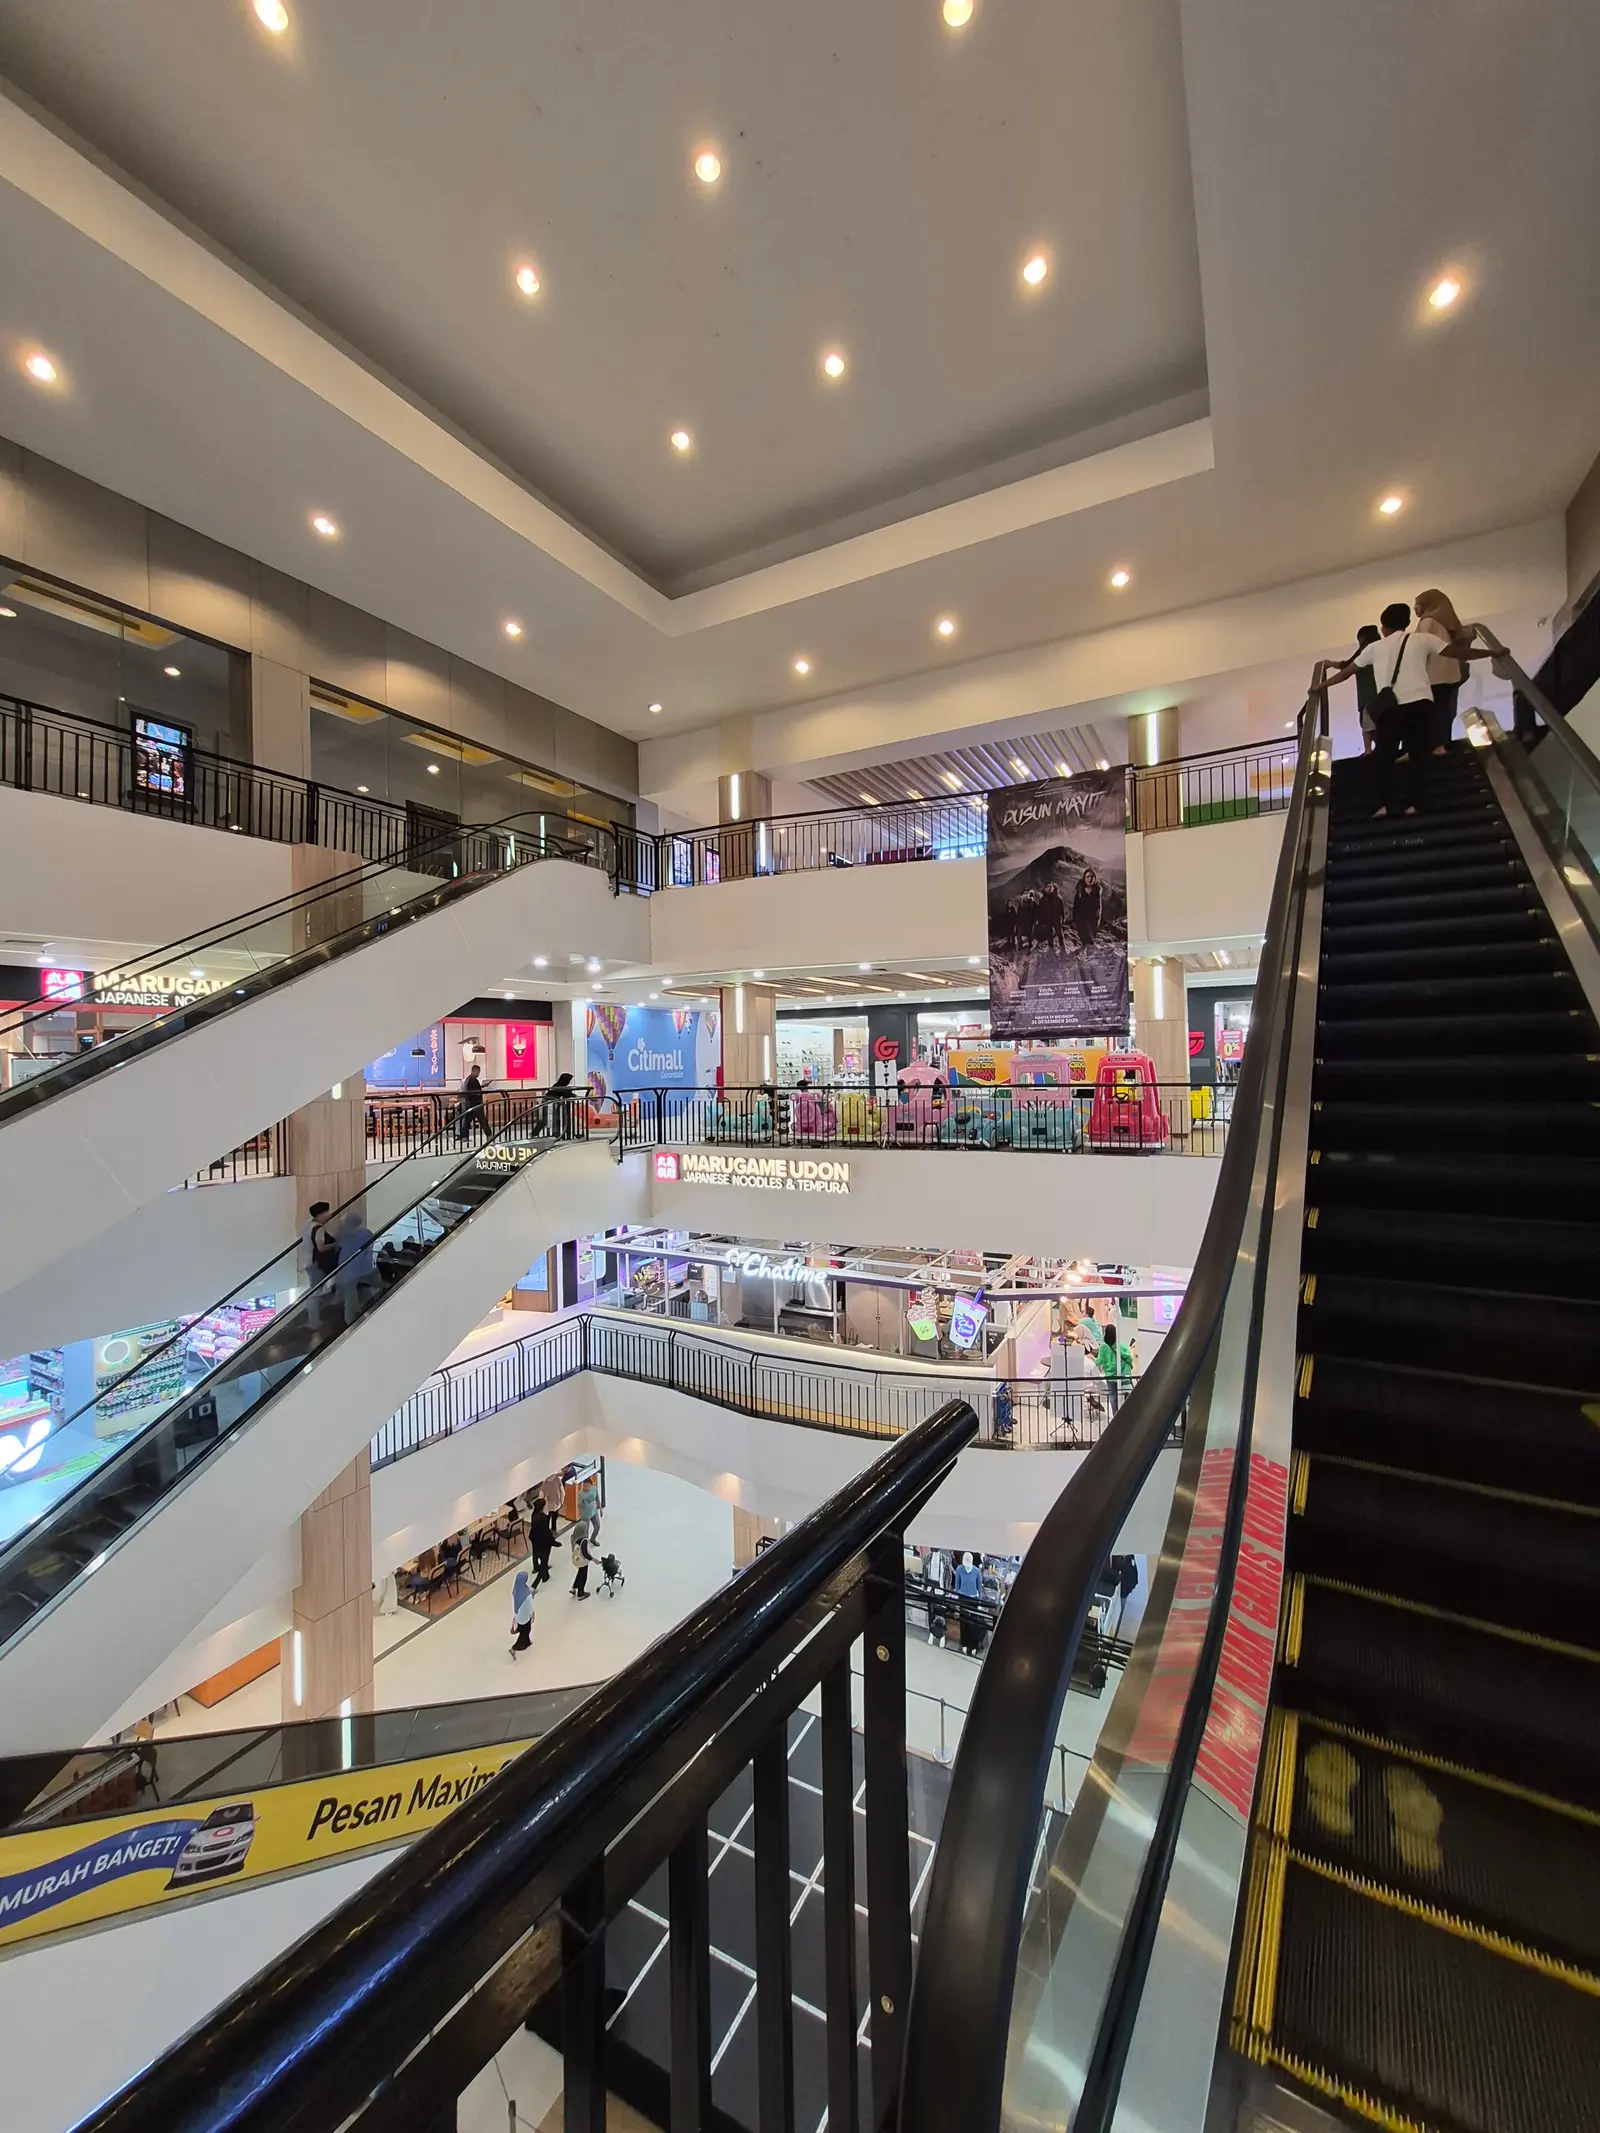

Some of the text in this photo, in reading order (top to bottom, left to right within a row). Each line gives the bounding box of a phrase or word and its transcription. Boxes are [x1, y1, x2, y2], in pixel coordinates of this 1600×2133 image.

[1002, 802, 1053, 827] DUSUN
[1056, 791, 1107, 817] MAYIT
[95, 991, 169, 1007] JAPANESE
[627, 1047, 684, 1072] Citimall
[682, 1154, 788, 1178] MARUGAME
[790, 1160, 850, 1181] UDON
[683, 1172, 850, 1194] JAPANESE NOODLES & TEMPURA
[742, 1253, 828, 1282] Chatime
[1242, 1452, 1288, 1552] KUNING
[1231, 1542, 1284, 1630] GARIS
[306, 1792, 403, 1841] Pesan
[0, 1836, 181, 1916] MURAH BANGET!
